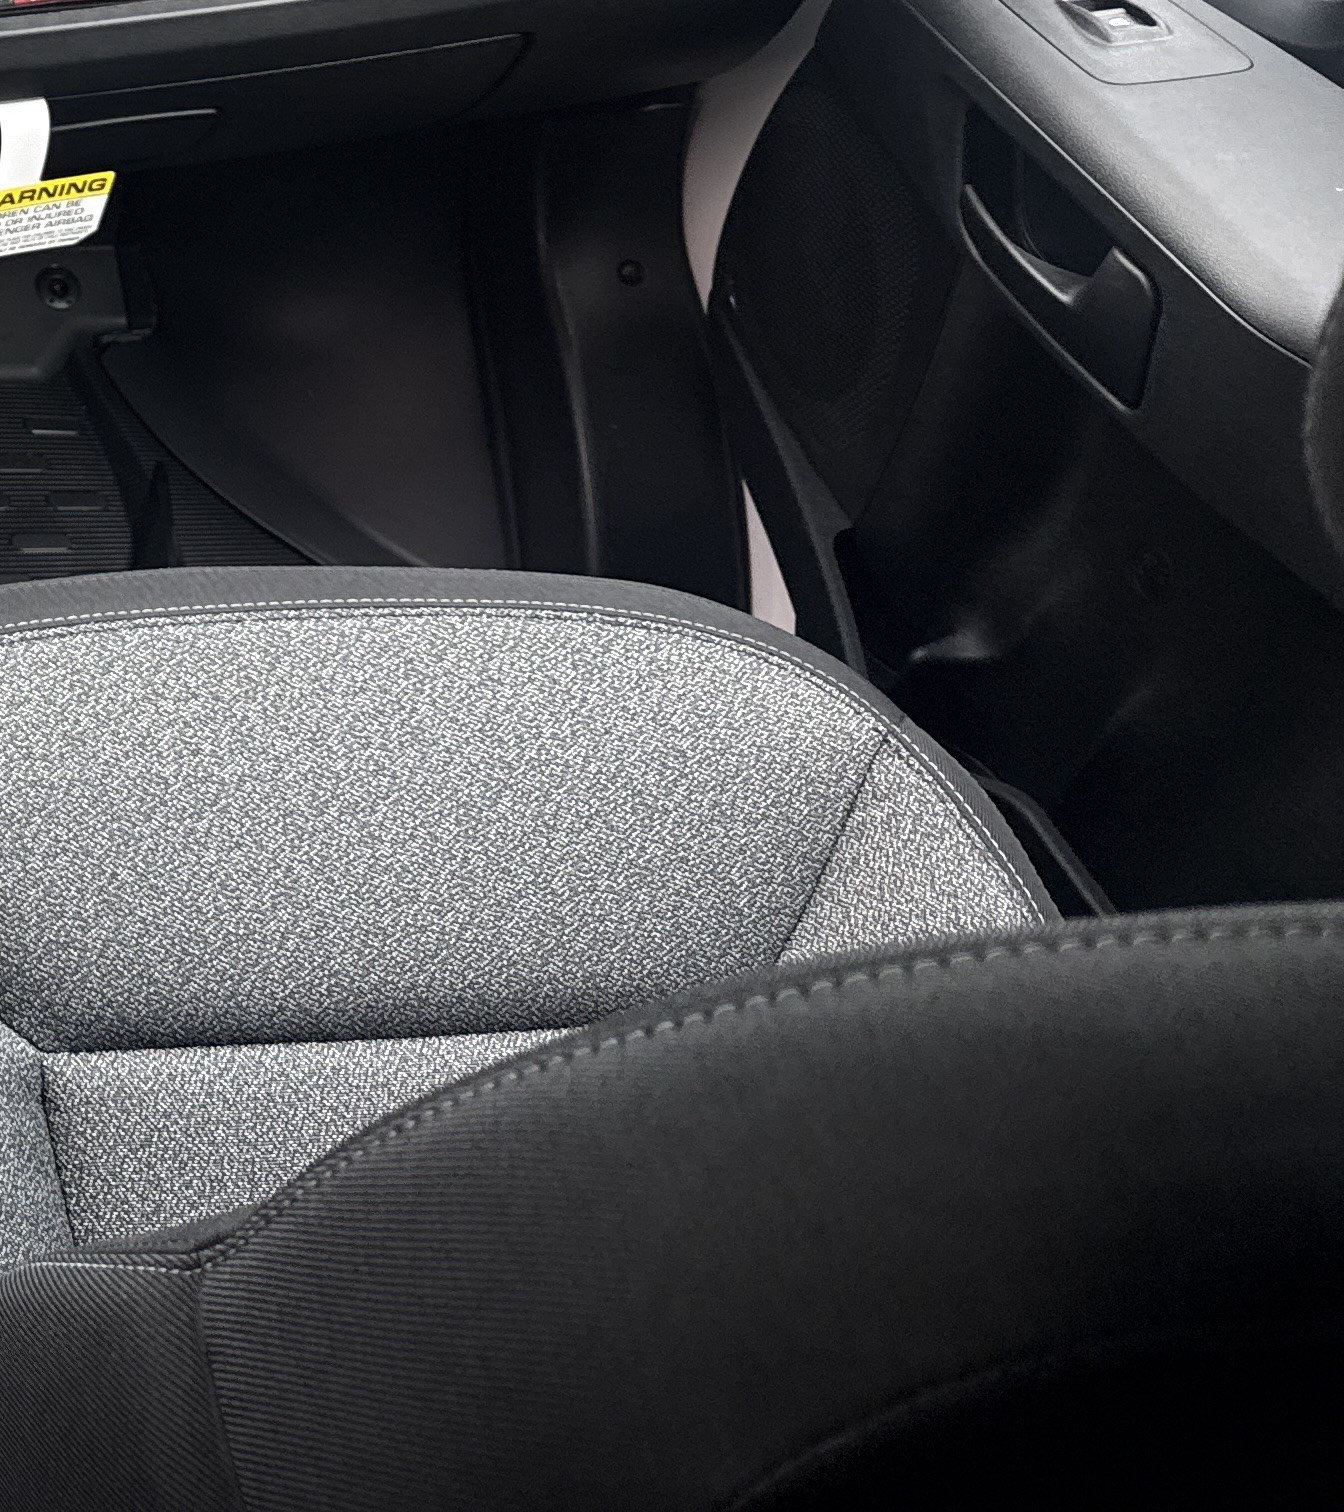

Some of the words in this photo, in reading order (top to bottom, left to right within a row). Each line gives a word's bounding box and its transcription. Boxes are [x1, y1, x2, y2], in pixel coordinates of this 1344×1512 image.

[33, 201, 62, 214] CAN
[65, 199, 82, 208] BE
[5, 217, 24, 227] OR
[27, 207, 85, 223] INJURED
[44, 214, 94, 228] AIRBAG
